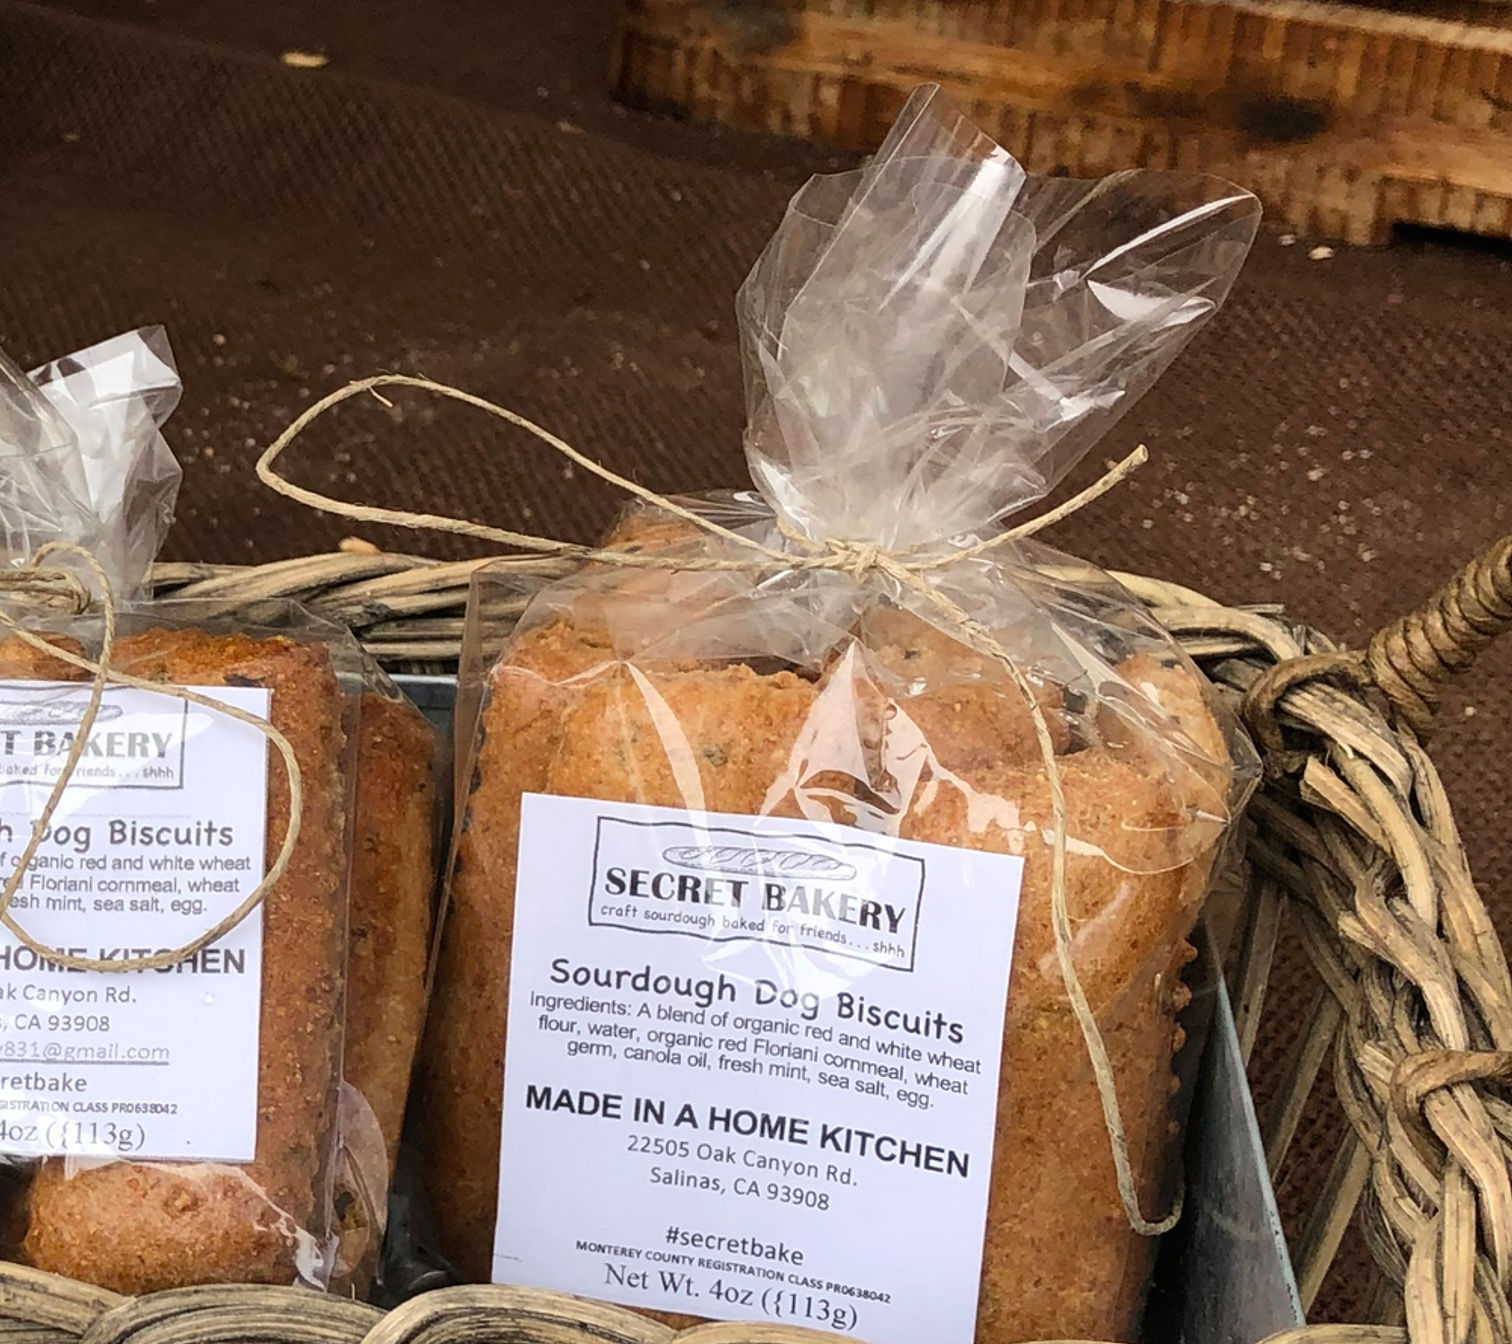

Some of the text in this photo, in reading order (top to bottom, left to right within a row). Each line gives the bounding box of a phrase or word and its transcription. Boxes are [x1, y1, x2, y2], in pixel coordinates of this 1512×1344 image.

[108, 818, 234, 847] Biscuits
[79, 852, 108, 871] red
[111, 854, 144, 872] and
[148, 855, 195, 871] white
[198, 855, 252, 871] wheat
[29, 873, 94, 893] Floriani
[96, 876, 182, 896] cornmeal,
[187, 876, 241, 893] wheat
[45, 895, 87, 913] mint,
[92, 898, 125, 912] sea
[128, 895, 165, 914] salt,
[170, 898, 207, 916] egg.
[604, 867, 906, 935] SECRET BAKERY
[600, 903, 638, 918] craft
[643, 909, 716, 930] sourdough
[722, 915, 766, 932] baked
[772, 919, 793, 935] for
[22, 983, 98, 1006] Canyon
[105, 985, 137, 1004] Rd.
[549, 958, 964, 1044] Sourdough Dog Biscuits
[14, 1013, 110, 1033] CA 93908
[530, 990, 982, 1075] Ingredients: A blend of organic red and white wheat
[538, 1014, 969, 1096] flour, water, organic red Floriani cornmeal, wheat
[566, 1040, 934, 1111] germ, canola oil, fresh mint, sea salt, egg.
[72, 1101, 109, 1114] CLASS
[46, 1121, 146, 1152] ({113g)
[525, 1084, 970, 1179] MADE IN A HOME KITCHEN
[627, 1134, 857, 1187] 22505 Oak Canyon Rd.
[649, 1166, 830, 1211] Salinas, CA 93908
[665, 1225, 804, 1266] #secretbake
[575, 1240, 892, 1305] MONTEREY COUNTY REGISTRATION CLASS PR0638042
[604, 1262, 858, 1331] Net Wt. 4oz ({113g)
